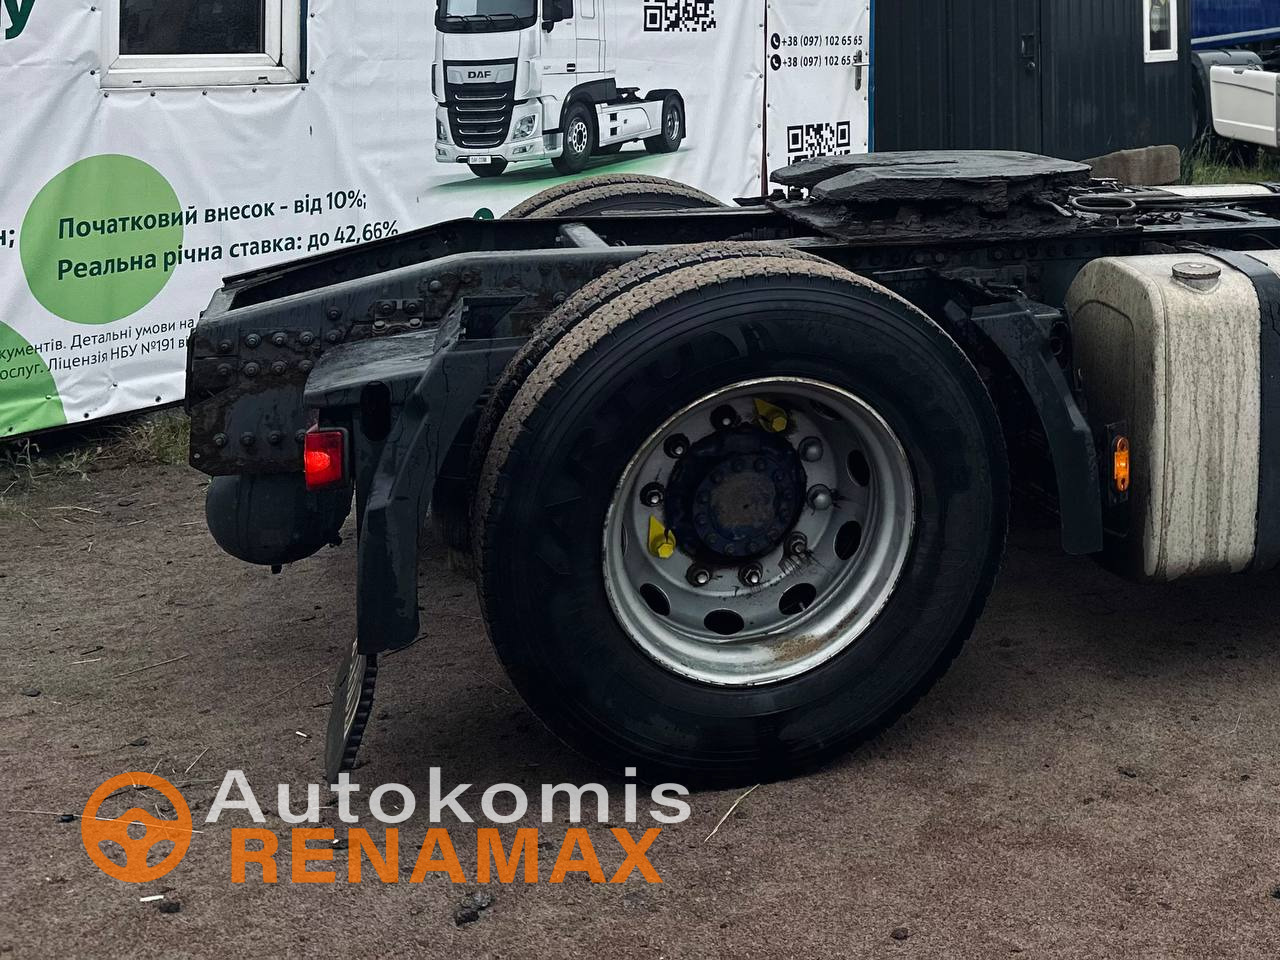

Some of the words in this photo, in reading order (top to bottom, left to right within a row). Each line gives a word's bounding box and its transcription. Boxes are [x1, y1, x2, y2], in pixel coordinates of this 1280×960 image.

[781, 35, 798, 47] +38
[800, 34, 822, 48] (097)
[825, 35, 840, 46] 102
[841, 35, 852, 46] 65
[853, 35, 863, 46] 65
[467, 70, 492, 79] DAF
[782, 56, 798, 68] +38
[800, 55, 822, 68] (097)
[824, 55, 839, 66] 102
[841, 55, 851, 66] 65
[58, 205, 197, 239] Початковий
[204, 201, 275, 223] внесок
[294, 195, 322, 216] від
[327, 189, 367, 211] 10%;
[58, 253, 156, 280] Реальна
[163, 244, 222, 273] річна
[229, 232, 302, 258] ставка:
[307, 231, 329, 252] до
[71, 326, 132, 350] Детальні
[136, 323, 175, 341] умови
[180, 319, 194, 330] на
[0, 363, 44, 380] ослуг.
[47, 351, 108, 371] Ліцензія
[110, 344, 138, 361] НБУ
[141, 337, 175, 355] №191
